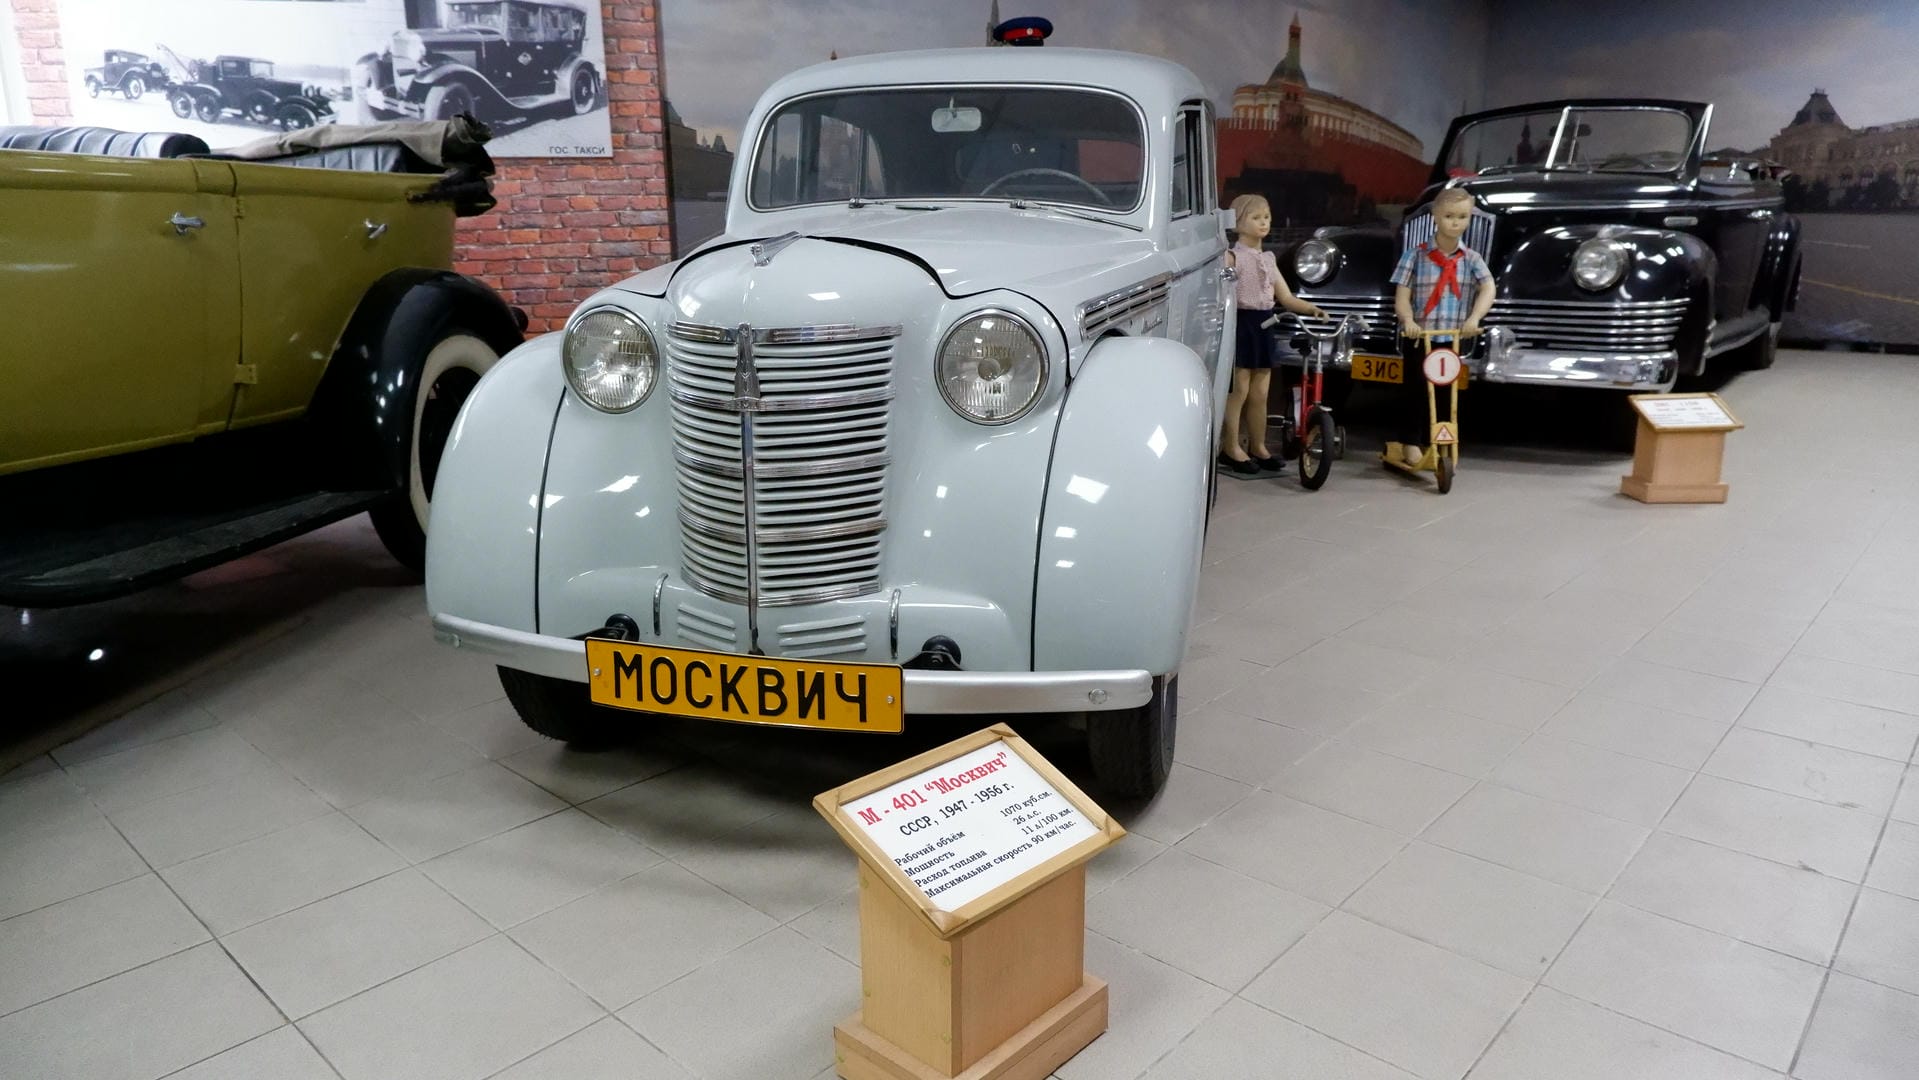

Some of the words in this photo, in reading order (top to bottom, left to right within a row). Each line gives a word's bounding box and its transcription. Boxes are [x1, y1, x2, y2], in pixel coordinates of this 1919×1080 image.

[549, 146, 569, 154] ГОС
[574, 146, 606, 154] ТАКСИ
[1361, 359, 1399, 380] ЗИС
[613, 650, 867, 723] МОСКВИЧ
[857, 807, 883, 826] М
[892, 789, 928, 811] 401
[939, 800, 968, 819] 1947
[974, 784, 1003, 803] 1956
[1002, 782, 1015, 791] г.
[894, 843, 936, 866] Рабочий
[936, 831, 966, 848] объём
[999, 803, 1022, 817] 1070
[1012, 815, 1026, 825] 26
[914, 868, 950, 888] Расход
[949, 849, 988, 872] топлива
[1021, 825, 1034, 835] 11
[1034, 813, 1059, 830] л/100
[1058, 808, 1074, 818] км.
[924, 861, 994, 899] Максимальная
[993, 842, 1033, 865] скорость
[1030, 834, 1045, 844] 90
[1044, 820, 1077, 839] км/час.
